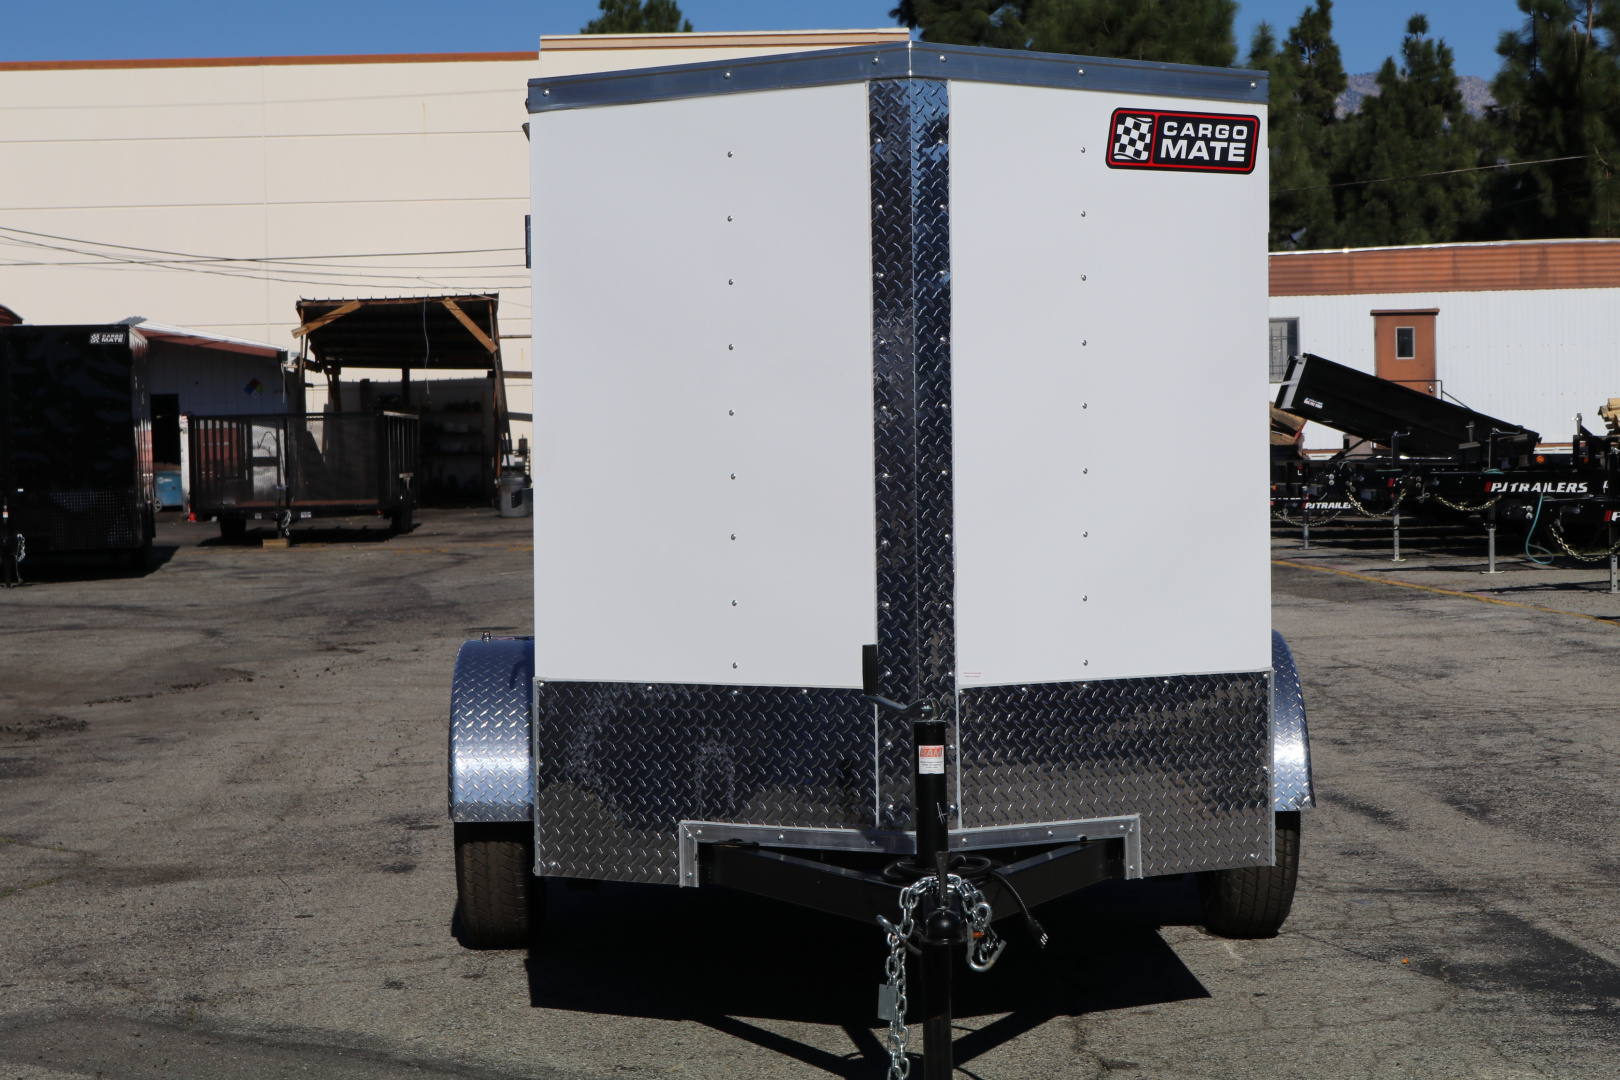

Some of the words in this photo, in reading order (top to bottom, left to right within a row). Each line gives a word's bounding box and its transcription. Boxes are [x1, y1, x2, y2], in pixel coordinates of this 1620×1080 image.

[1163, 121, 1248, 140] CARGO
[1160, 138, 1247, 162] MATE
[1490, 481, 1509, 493] PJ
[1509, 481, 1588, 493] TRAILERS
[920, 748, 942, 757] RAM
